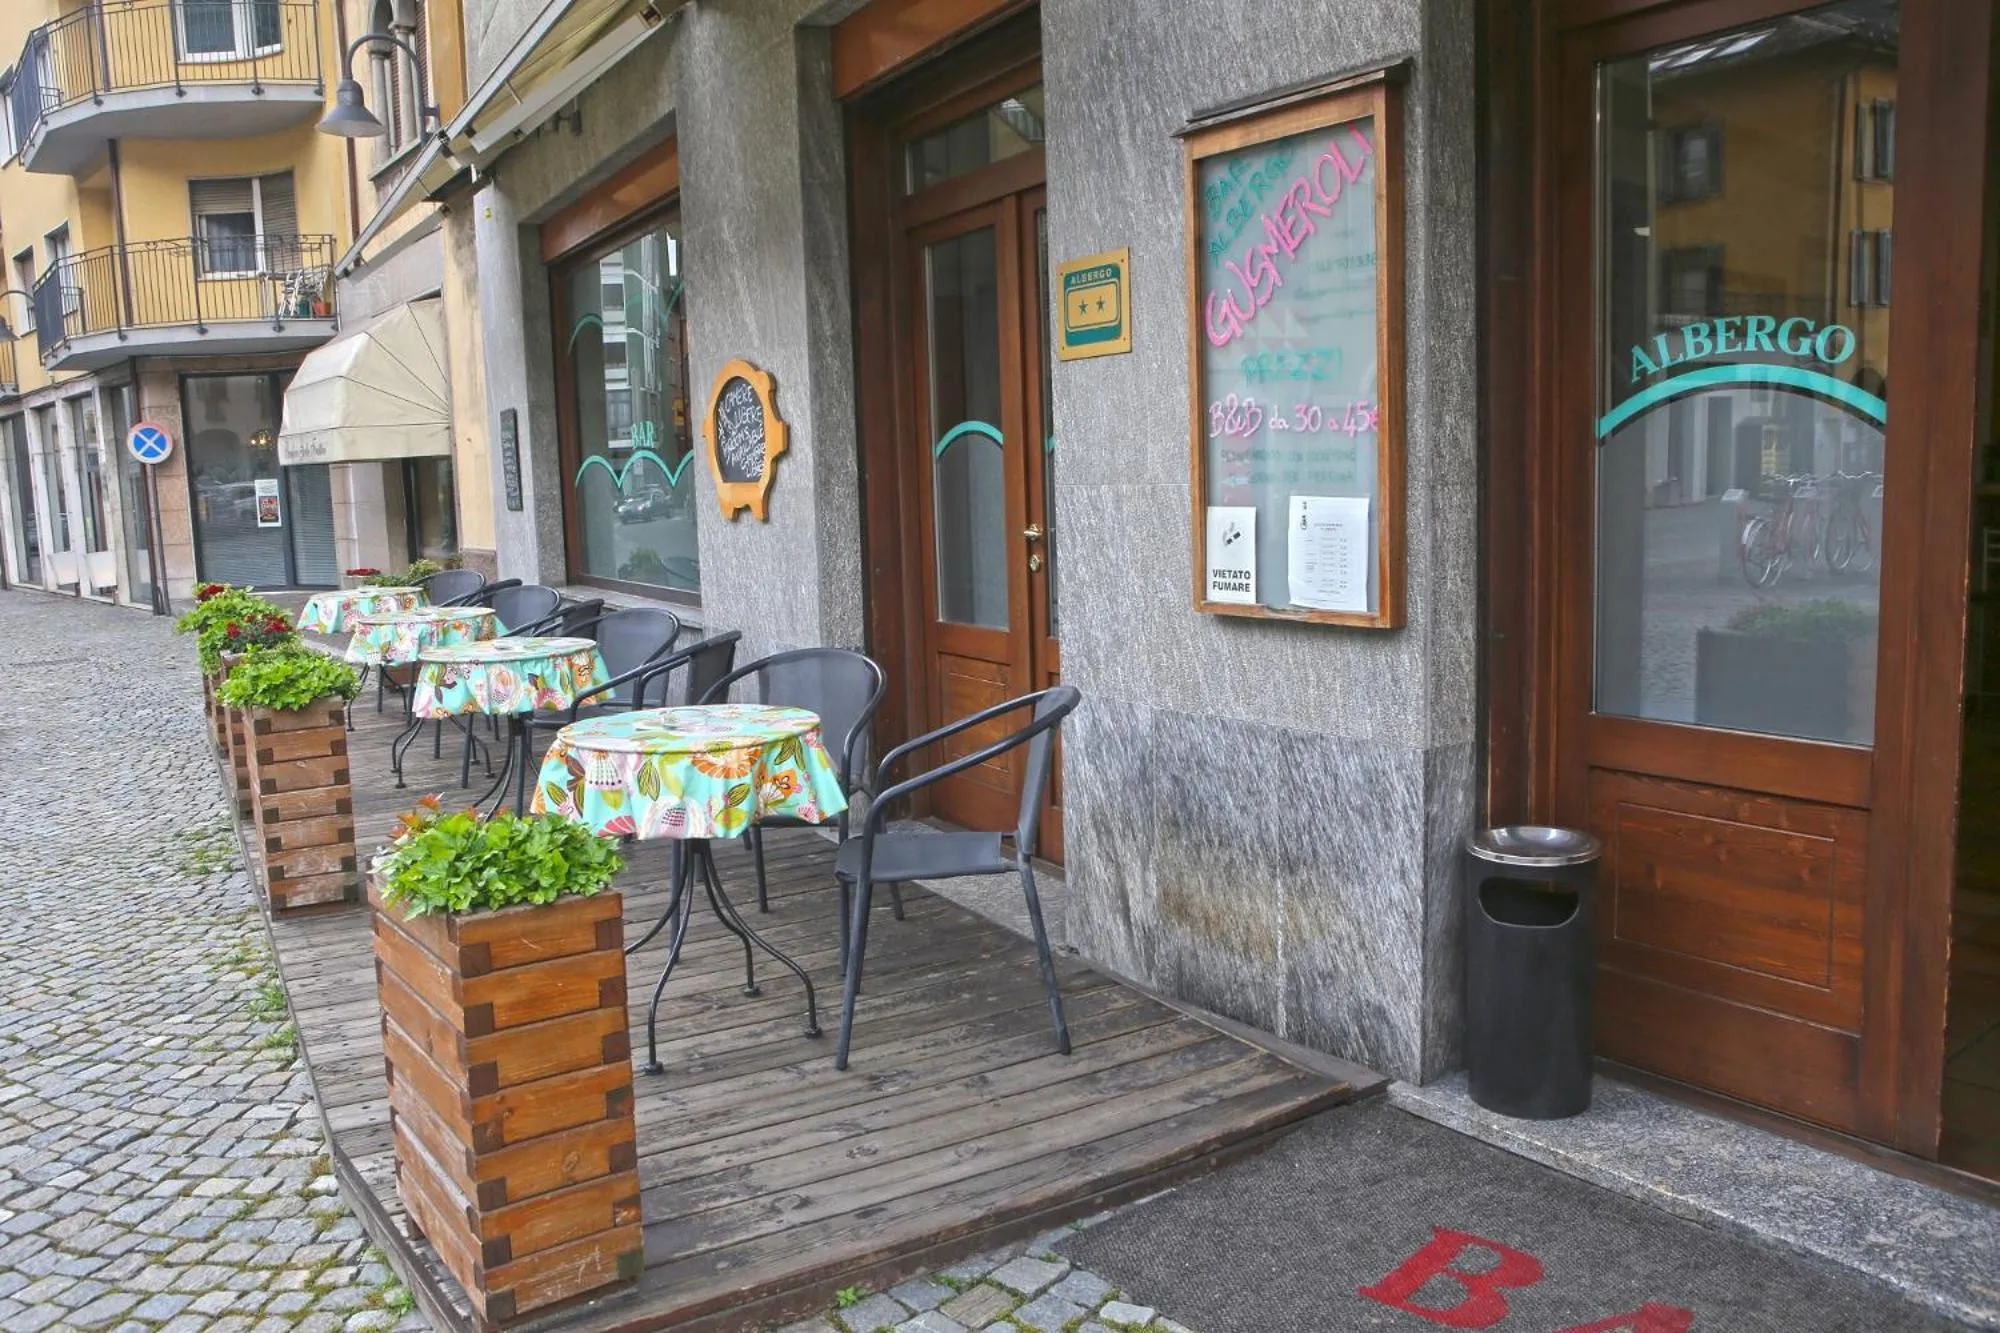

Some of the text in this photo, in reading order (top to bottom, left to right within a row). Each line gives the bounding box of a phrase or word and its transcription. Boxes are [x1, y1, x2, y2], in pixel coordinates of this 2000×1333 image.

[1071, 267, 1113, 285] ALBERGO
[1630, 315, 1856, 384] ALBERGO
[1209, 391, 1263, 438] B&B
[1268, 404, 1290, 430] da
[1293, 402, 1323, 432] 30
[1327, 417, 1339, 430] a
[630, 420, 656, 450] BAR
[1212, 568, 1252, 580] VIETATO
[1212, 580, 1252, 593] FUMARE
